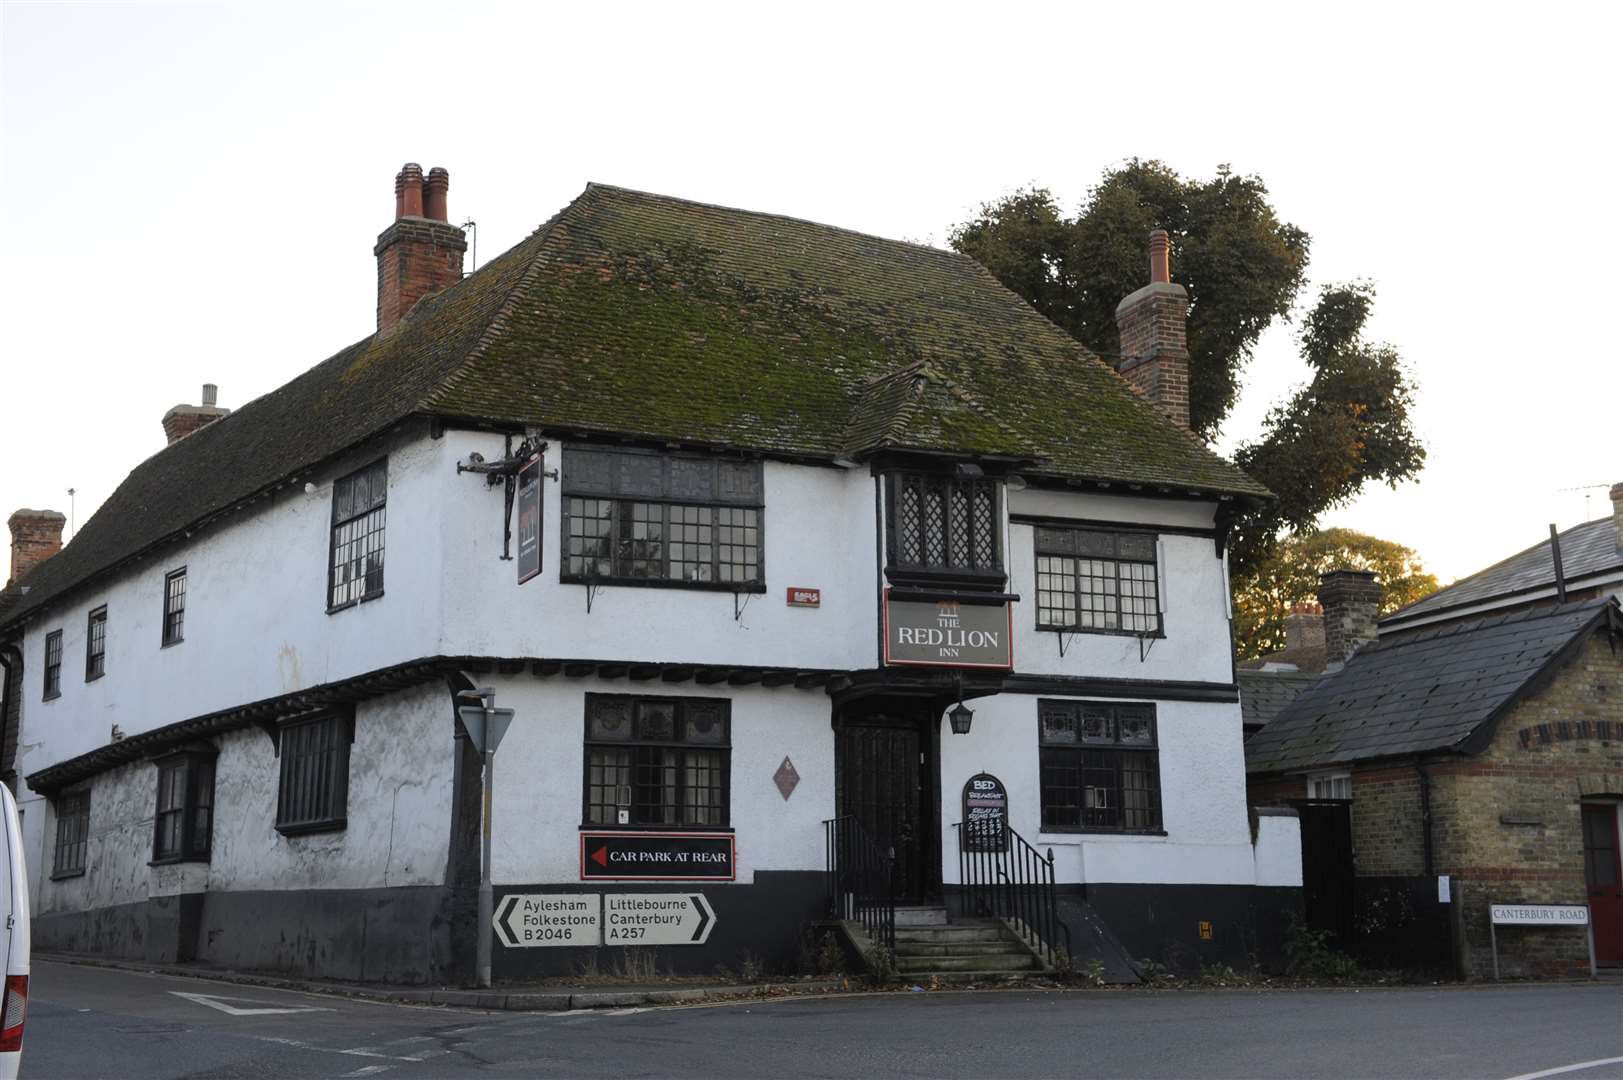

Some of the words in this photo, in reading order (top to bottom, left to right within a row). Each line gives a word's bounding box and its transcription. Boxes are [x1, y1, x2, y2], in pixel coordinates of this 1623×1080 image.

[936, 618, 960, 628] THE
[898, 627, 944, 645] RED
[947, 629, 999, 648] LION
[939, 647, 960, 657] INN
[973, 780, 996, 790] BED
[609, 851, 637, 862] CAR
[639, 851, 672, 862] PARK
[674, 852, 690, 862] AT
[692, 852, 727, 862] REAR
[523, 899, 588, 914] Aylesham
[610, 899, 688, 910] Littlebourne
[609, 913, 683, 926] Canterbury
[1493, 908, 1555, 920] CANTERBURY
[1559, 910, 1586, 920] ROAD
[523, 914, 597, 926] Folkestone
